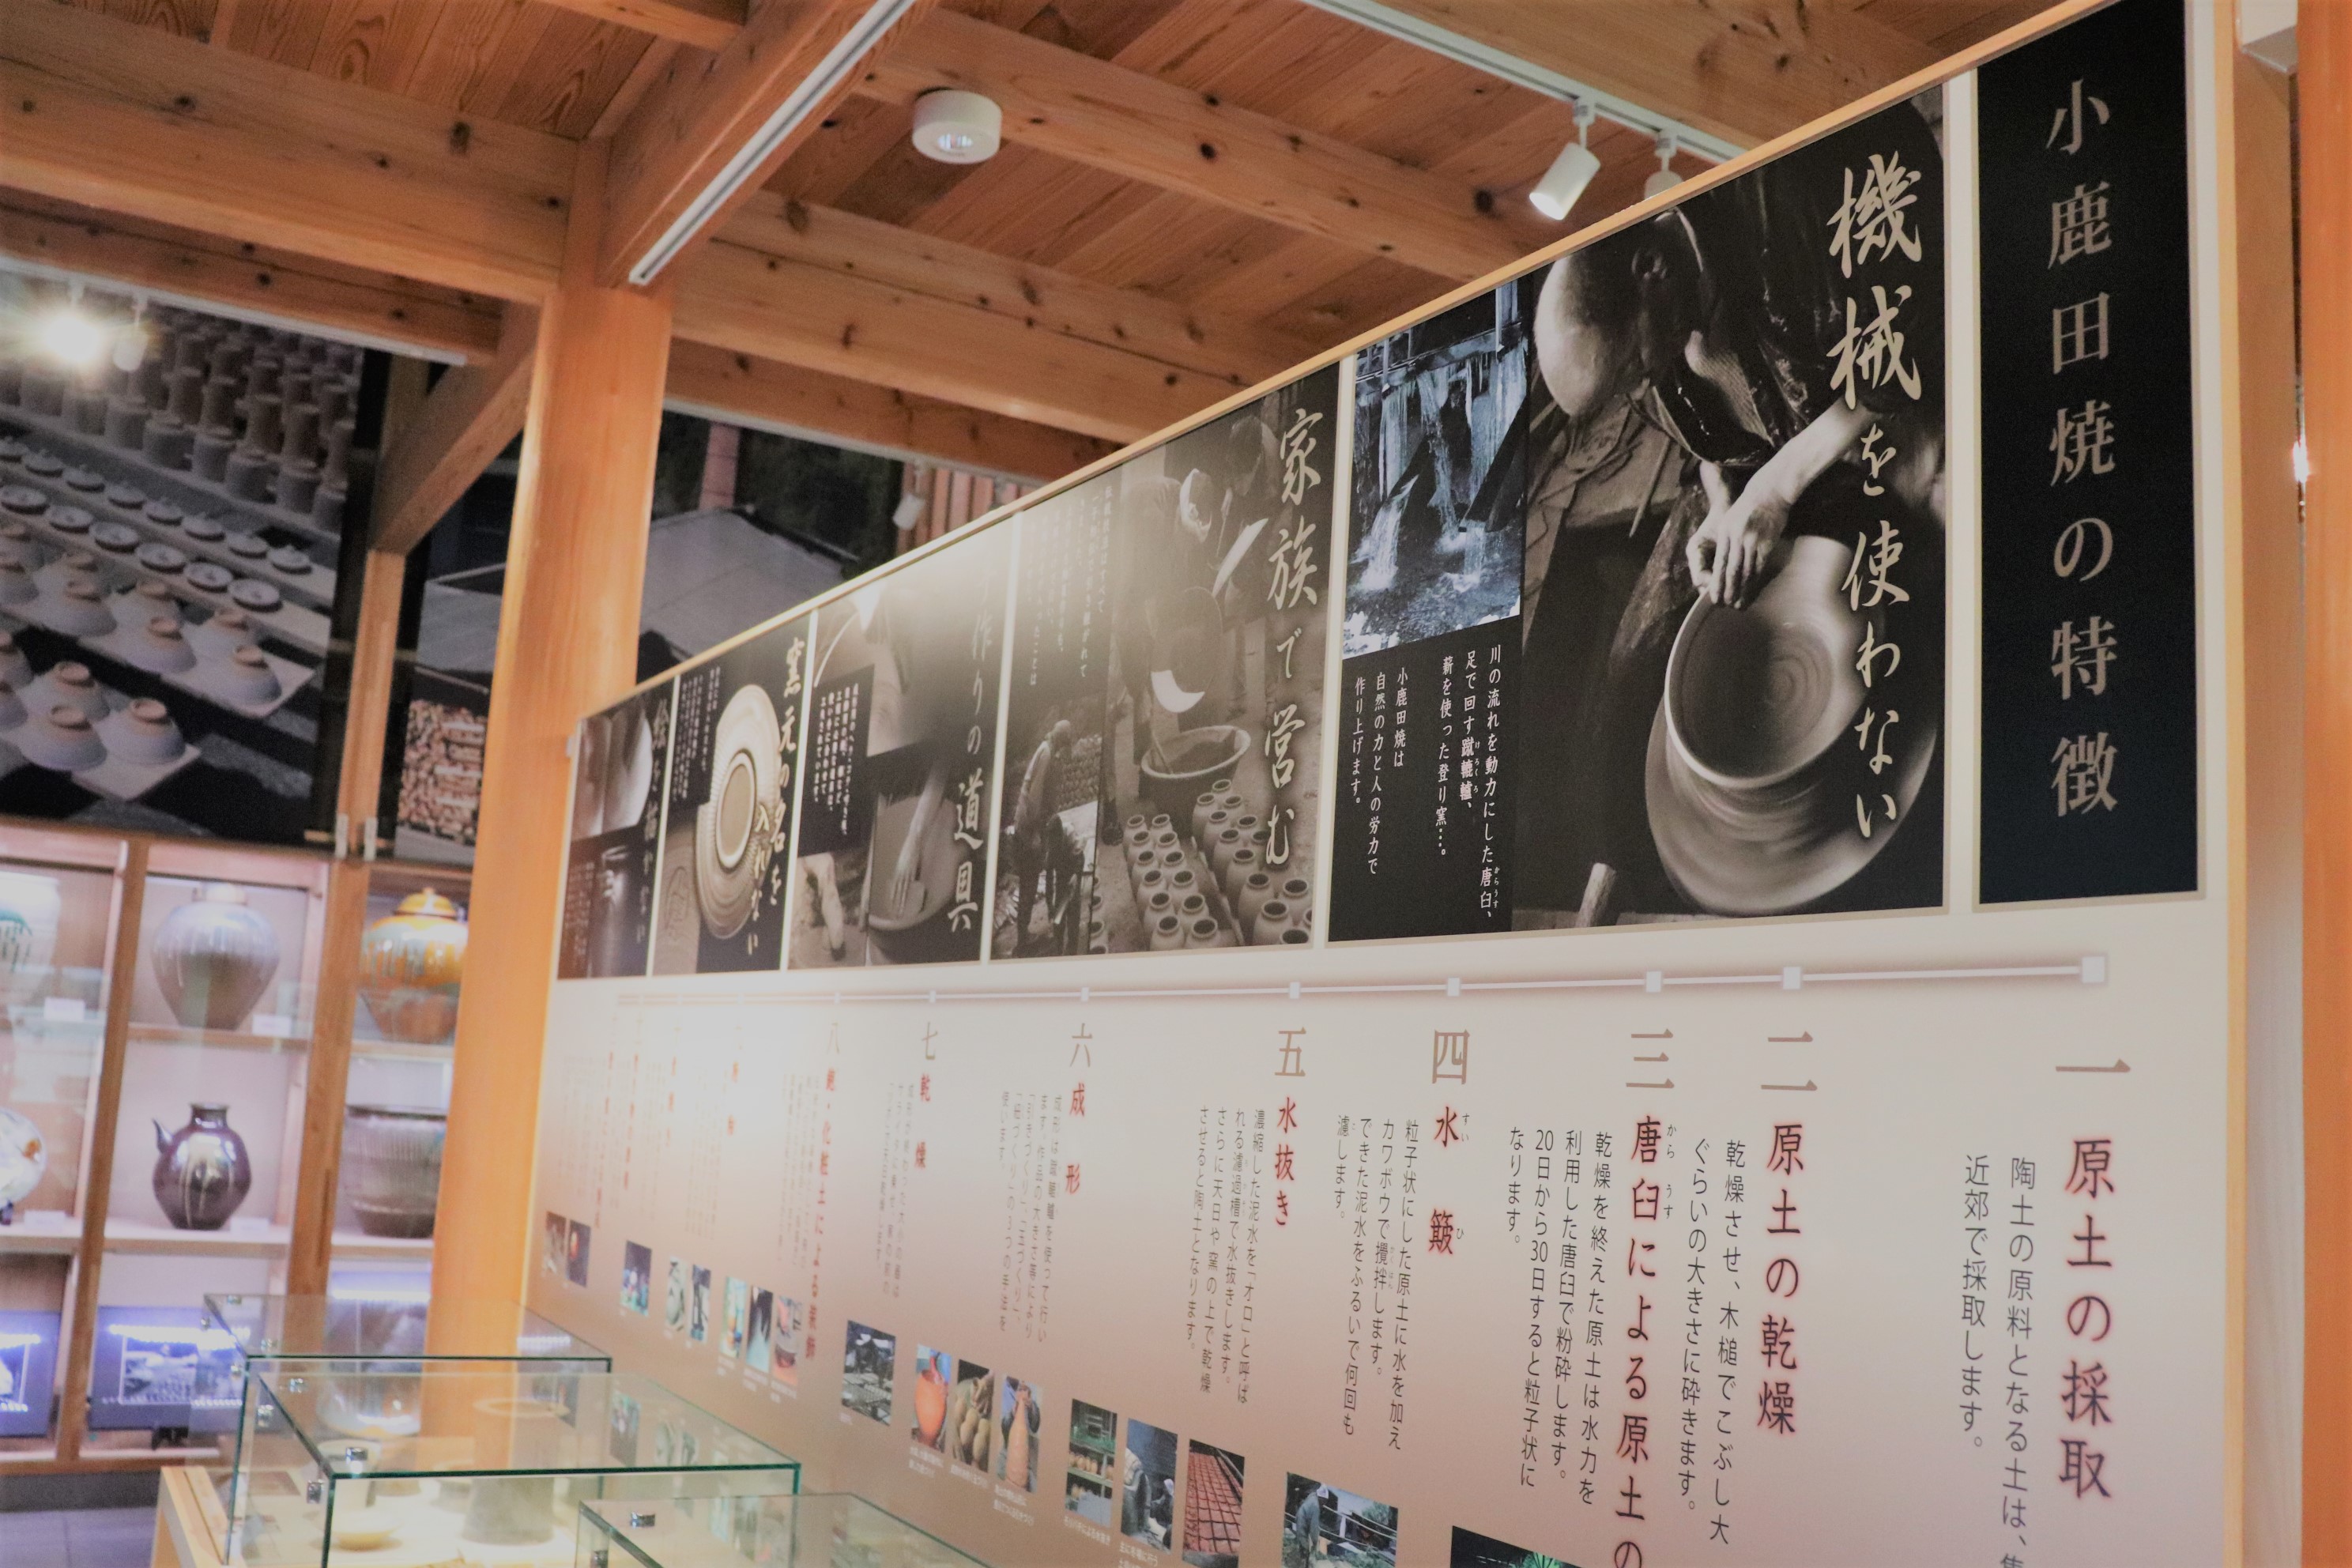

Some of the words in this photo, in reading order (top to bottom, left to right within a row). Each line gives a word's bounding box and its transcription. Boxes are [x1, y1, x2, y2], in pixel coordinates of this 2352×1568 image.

[1826, 150, 1922, 839] 機械を使わない
[2046, 78, 2118, 817] 小鹿田焼の特徴
[1265, 408, 1324, 865] 家族で営む
[1350, 677, 1366, 804] 作り上げます。
[1368, 672, 1385, 875] 自然の力と人の労力で
[1393, 666, 1408, 767] 小鹿田焼は
[1479, 643, 1502, 918] 川の流れを動力にした唐臼、
[922, 1021, 938, 1061] 七
[1065, 1082, 1086, 1195] 成形
[1069, 1022, 1093, 1068] 六
[1274, 1027, 1306, 1078] 五
[1274, 1096, 1298, 1227] 水抜き
[1431, 1029, 1471, 1085] 四
[1506, 1126, 1525, 1244] なります。
[1625, 1028, 1675, 1090] 三
[1760, 1031, 1818, 1092] 二
[1344, 1118, 1372, 1435] できた泥水をふるいで何回も
[1388, 1119, 1419, 1450] 粒子状にした原土に水を加え
[1521, 1129, 1555, 1487] 20日から30日すると粒子状に
[1551, 1129, 1582, 1480] 利用した唐臼で粉砕します。
[1579, 1131, 1612, 1505] 乾燥を終えた原土は水力を
[1613, 1115, 1661, 1568] 唐臼による原土の
[1679, 1138, 1710, 1510] ぐらいの大きさに砕きます。
[1709, 1140, 1746, 1545] 乾燥させ、木槌でこぶし大
[1756, 1122, 1805, 1435] 原土の乾燥
[1959, 1154, 1990, 1448] 近郊で採取します。
[2058, 1137, 2116, 1499] 原土の採取
